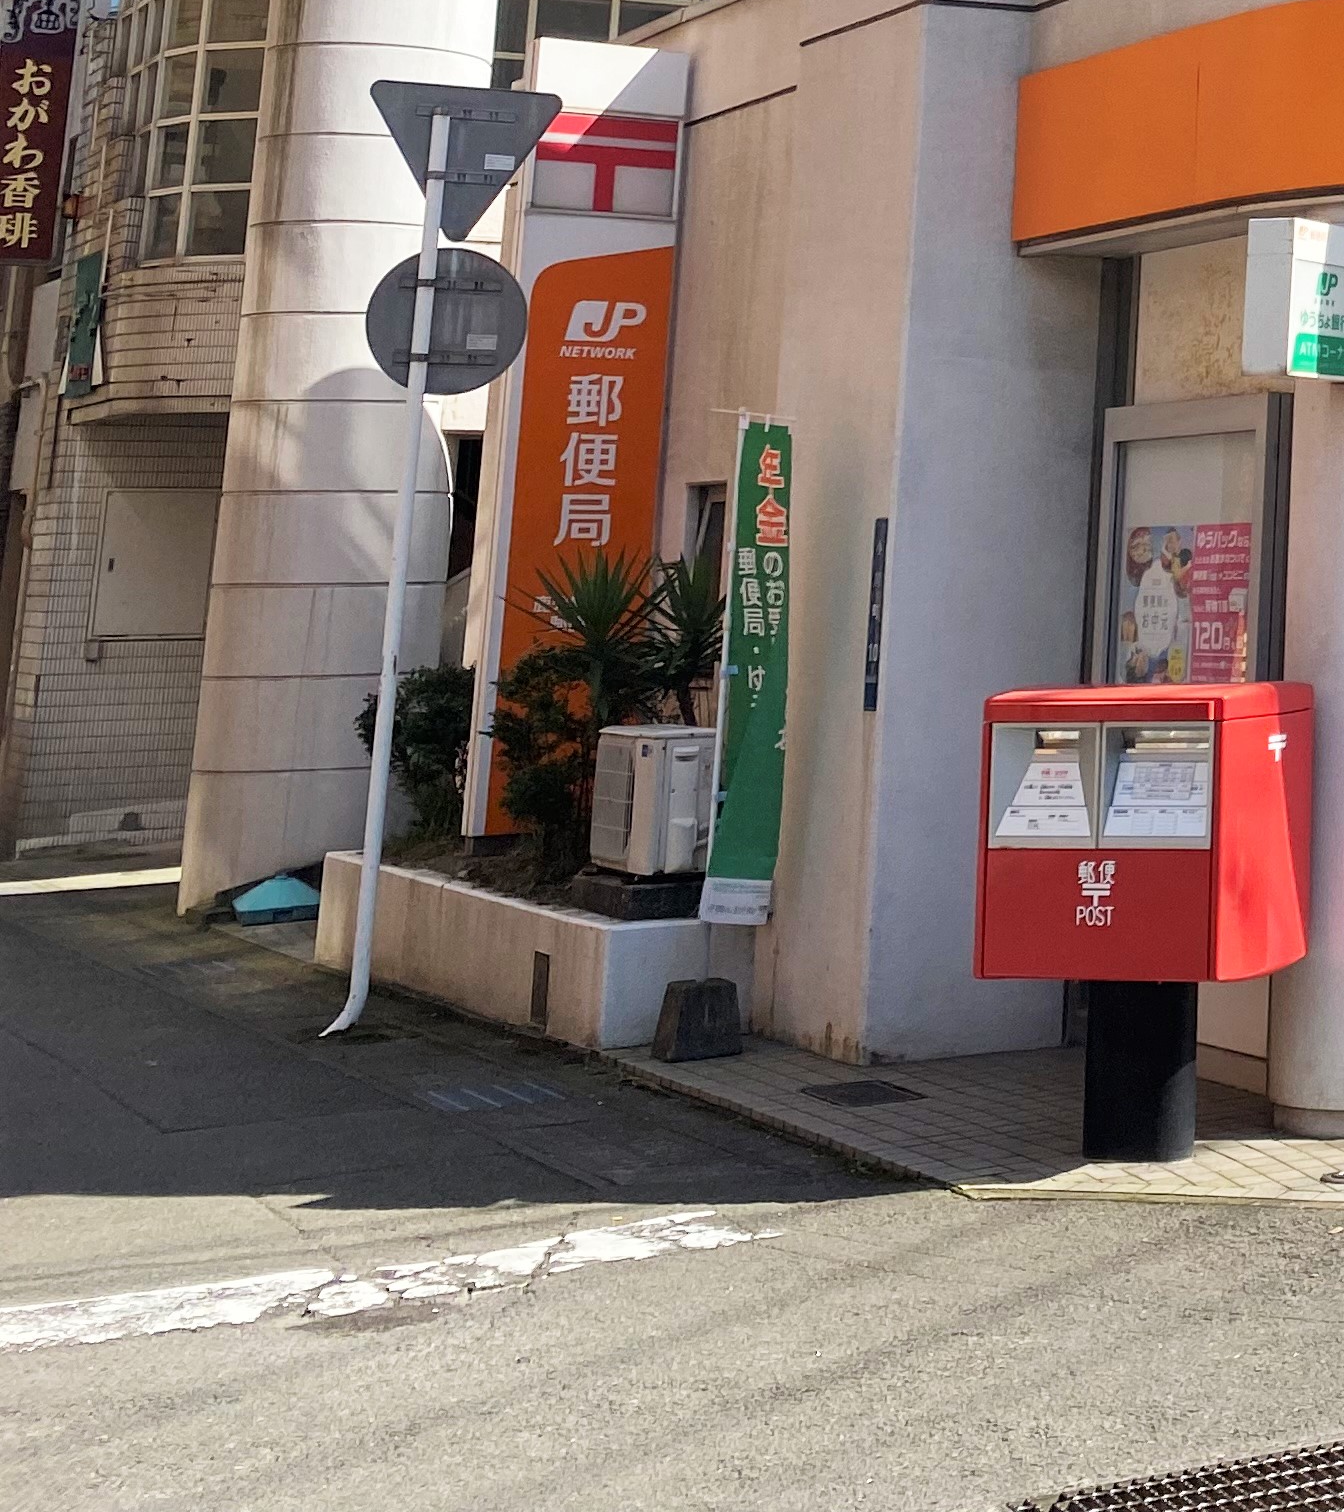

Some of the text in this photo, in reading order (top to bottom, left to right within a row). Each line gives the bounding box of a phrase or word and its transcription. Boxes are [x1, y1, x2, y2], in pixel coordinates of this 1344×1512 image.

[0, 58, 52, 248] おがわ香琲
[559, 345, 637, 360] NETWORK
[554, 374, 623, 548] 郵便局
[1077, 860, 1116, 884] 郵便
[1075, 906, 1115, 926] POST
